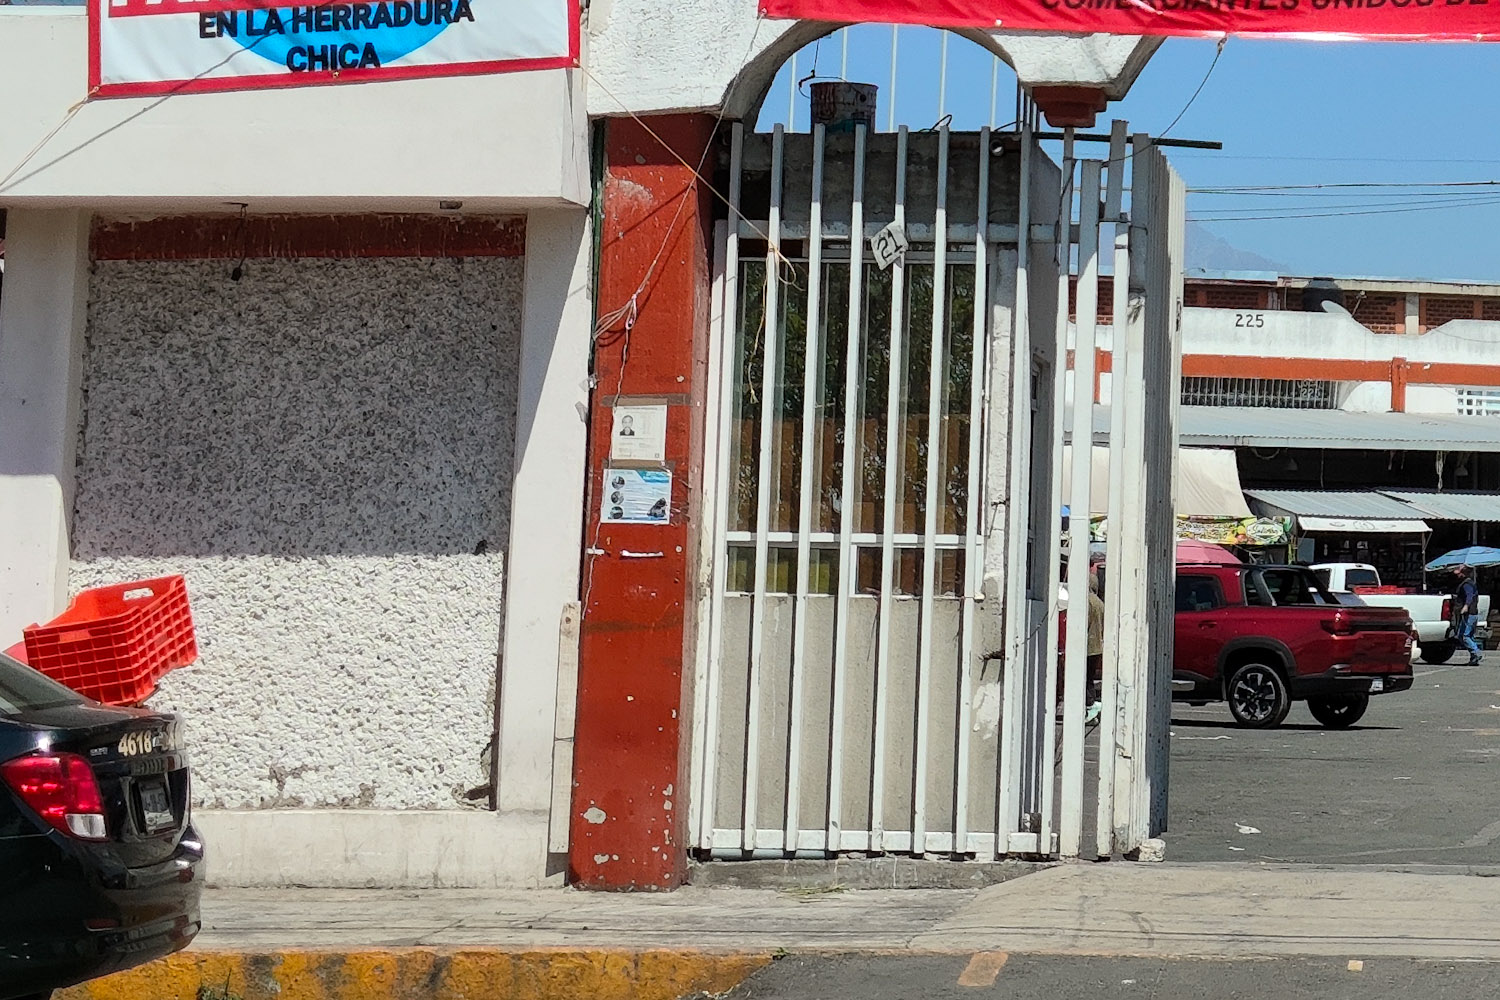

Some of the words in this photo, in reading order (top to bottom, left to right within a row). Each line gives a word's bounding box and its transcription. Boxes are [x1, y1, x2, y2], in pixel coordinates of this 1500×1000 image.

[199, 11, 237, 38] EN
[246, 8, 286, 37] LA
[286, 44, 380, 72] CHICA
[1235, 314, 1264, 327] 225
